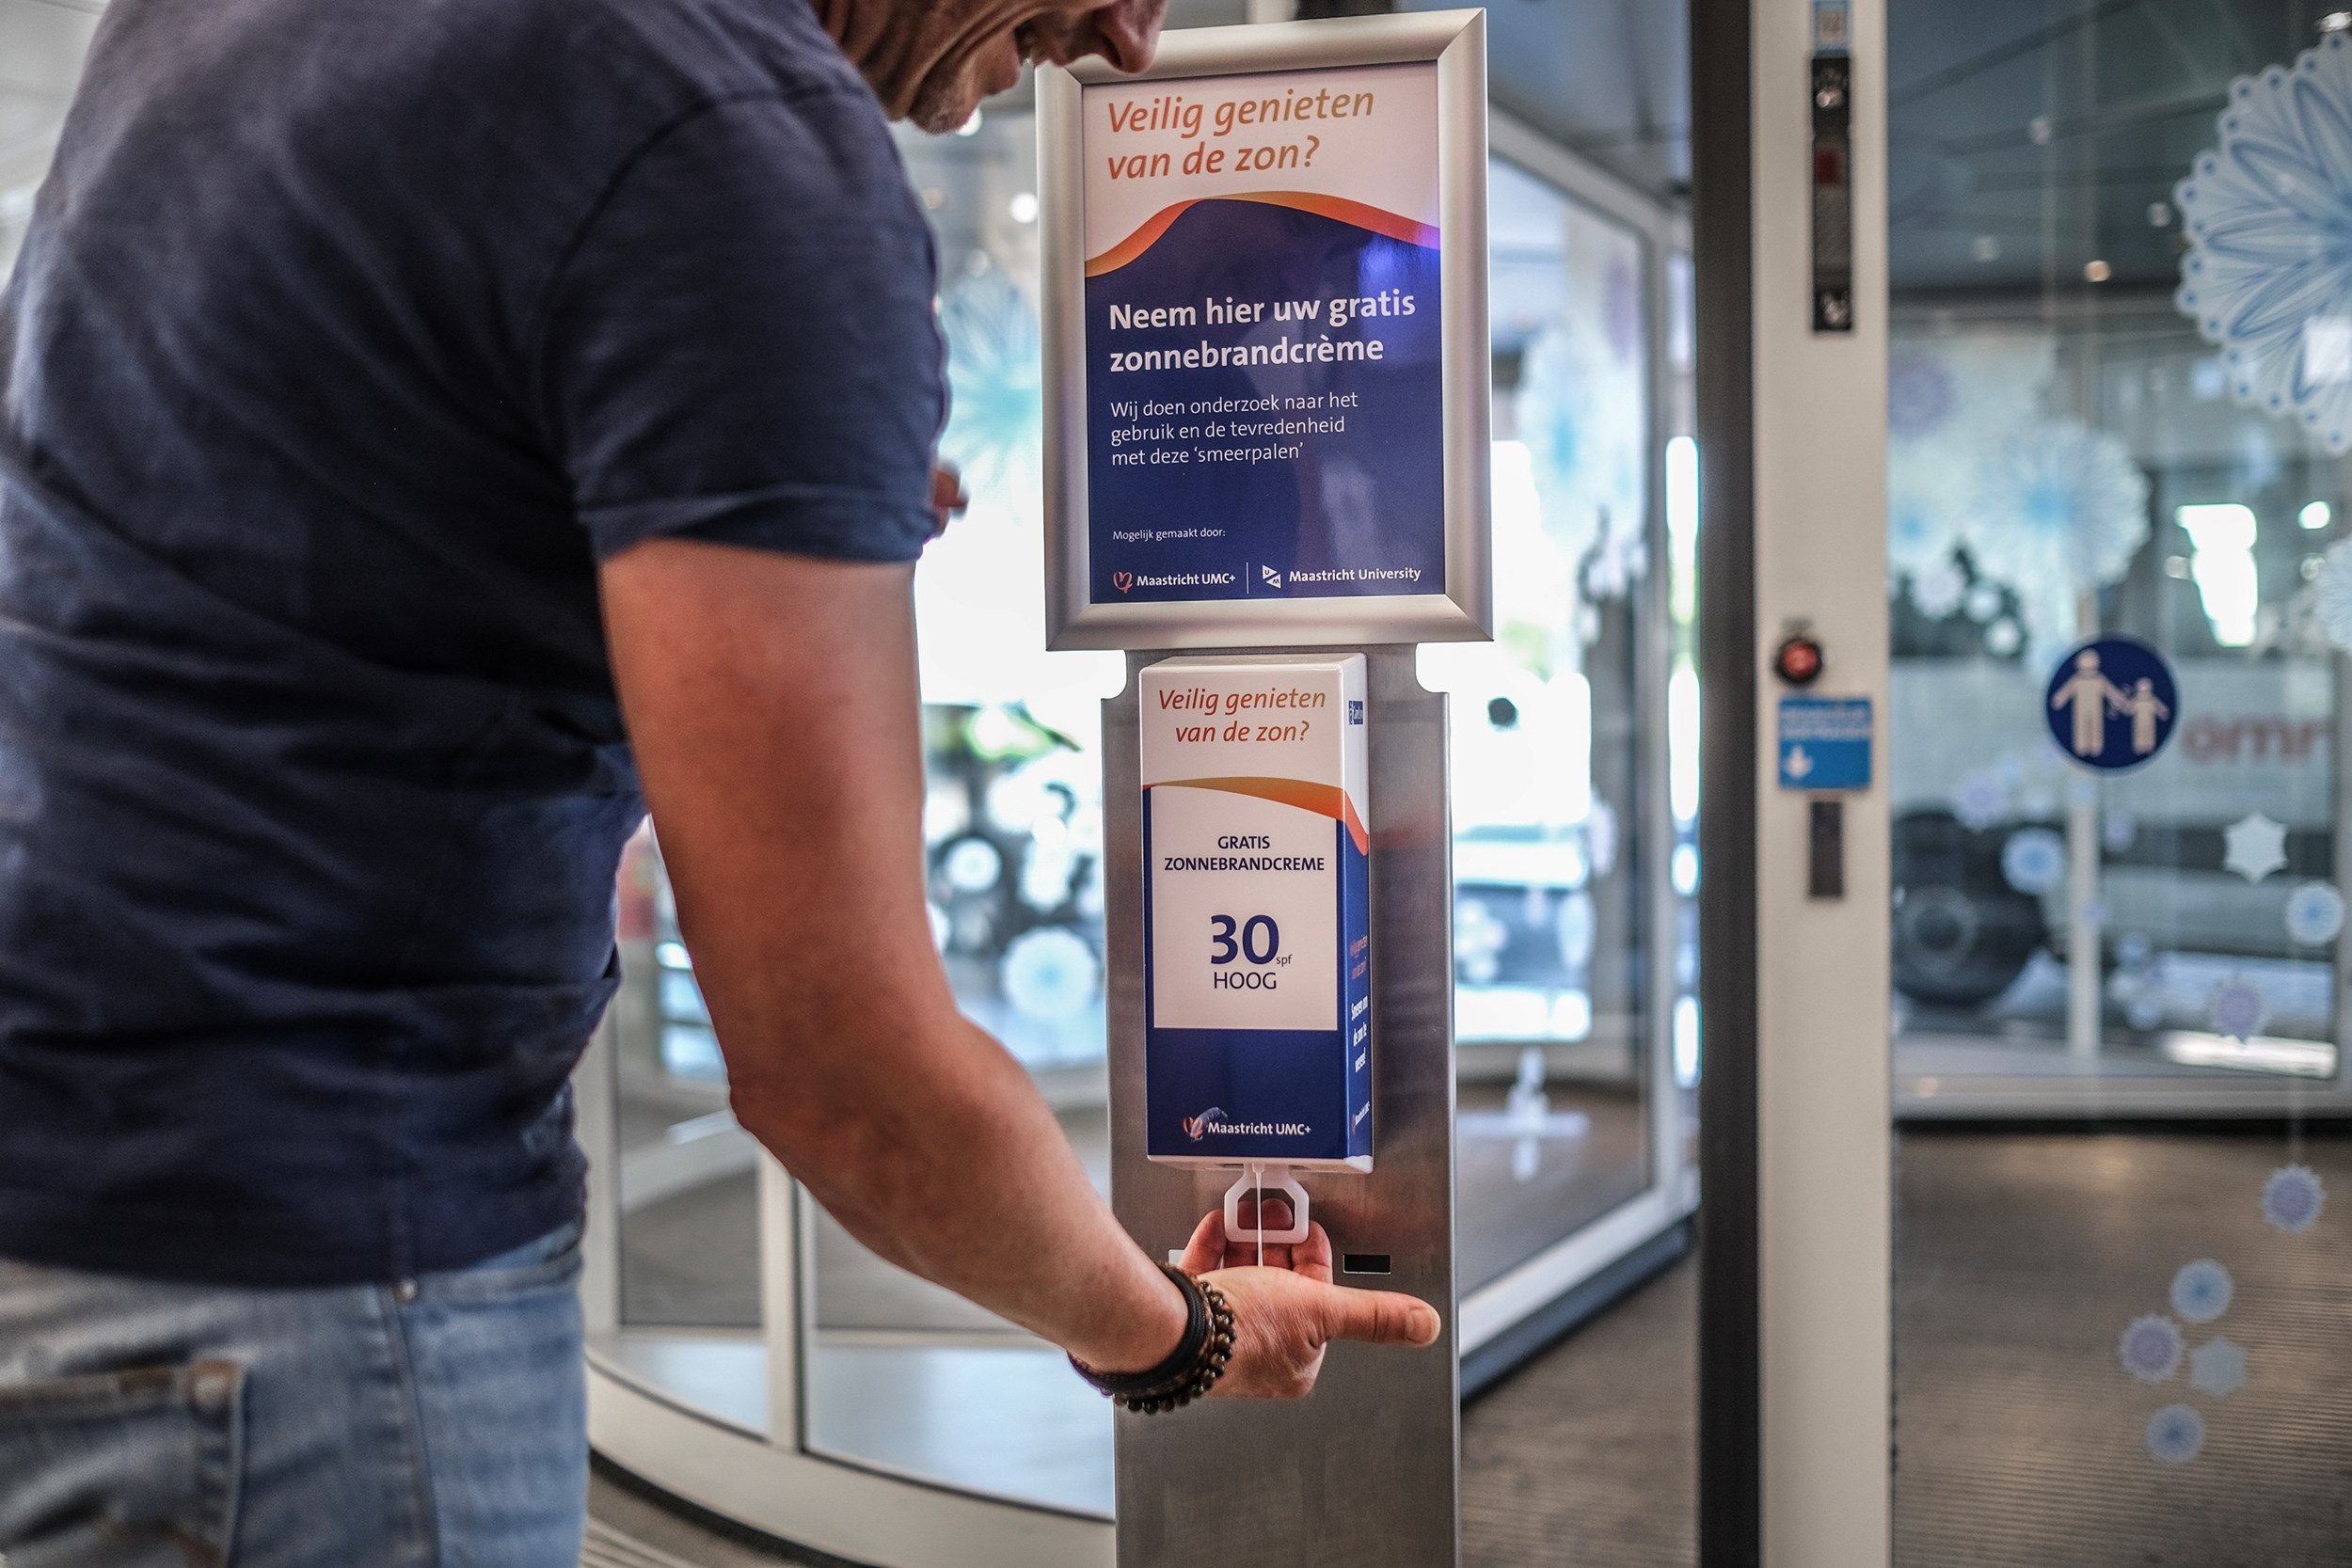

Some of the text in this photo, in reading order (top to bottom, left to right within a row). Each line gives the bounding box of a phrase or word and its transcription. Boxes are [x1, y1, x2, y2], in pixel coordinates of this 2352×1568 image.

[1107, 88, 1375, 138] Veilig genieten
[1107, 135, 1320, 180] van de zon?
[1109, 289, 1416, 329] Neem hier uw gratis
[1110, 334, 1384, 372] zonnebrandcrème
[1110, 392, 1359, 421] Wij doen onderzoek naar het
[1111, 416, 1344, 446] gebruik en de tevredenheid
[1112, 451, 1146, 465] met
[1150, 449, 1189, 464] deze
[1112, 528, 1226, 542] Mogelijk gemaakt door:
[1136, 574, 1235, 586] Maastricht UMC+
[1289, 567, 1422, 581] Maastricht University
[1158, 689, 1219, 715] Veilig
[1224, 688, 1326, 715] genieten
[1175, 721, 1310, 742] van de zon?
[1217, 836, 1270, 848] GRATIS
[1164, 858, 1325, 870] ZONNEBRANDCREME
[1210, 914, 1294, 967] 30 spf
[1214, 972, 1277, 990] HOOG
[1207, 1122, 1311, 1134] Maastricht UMC+
